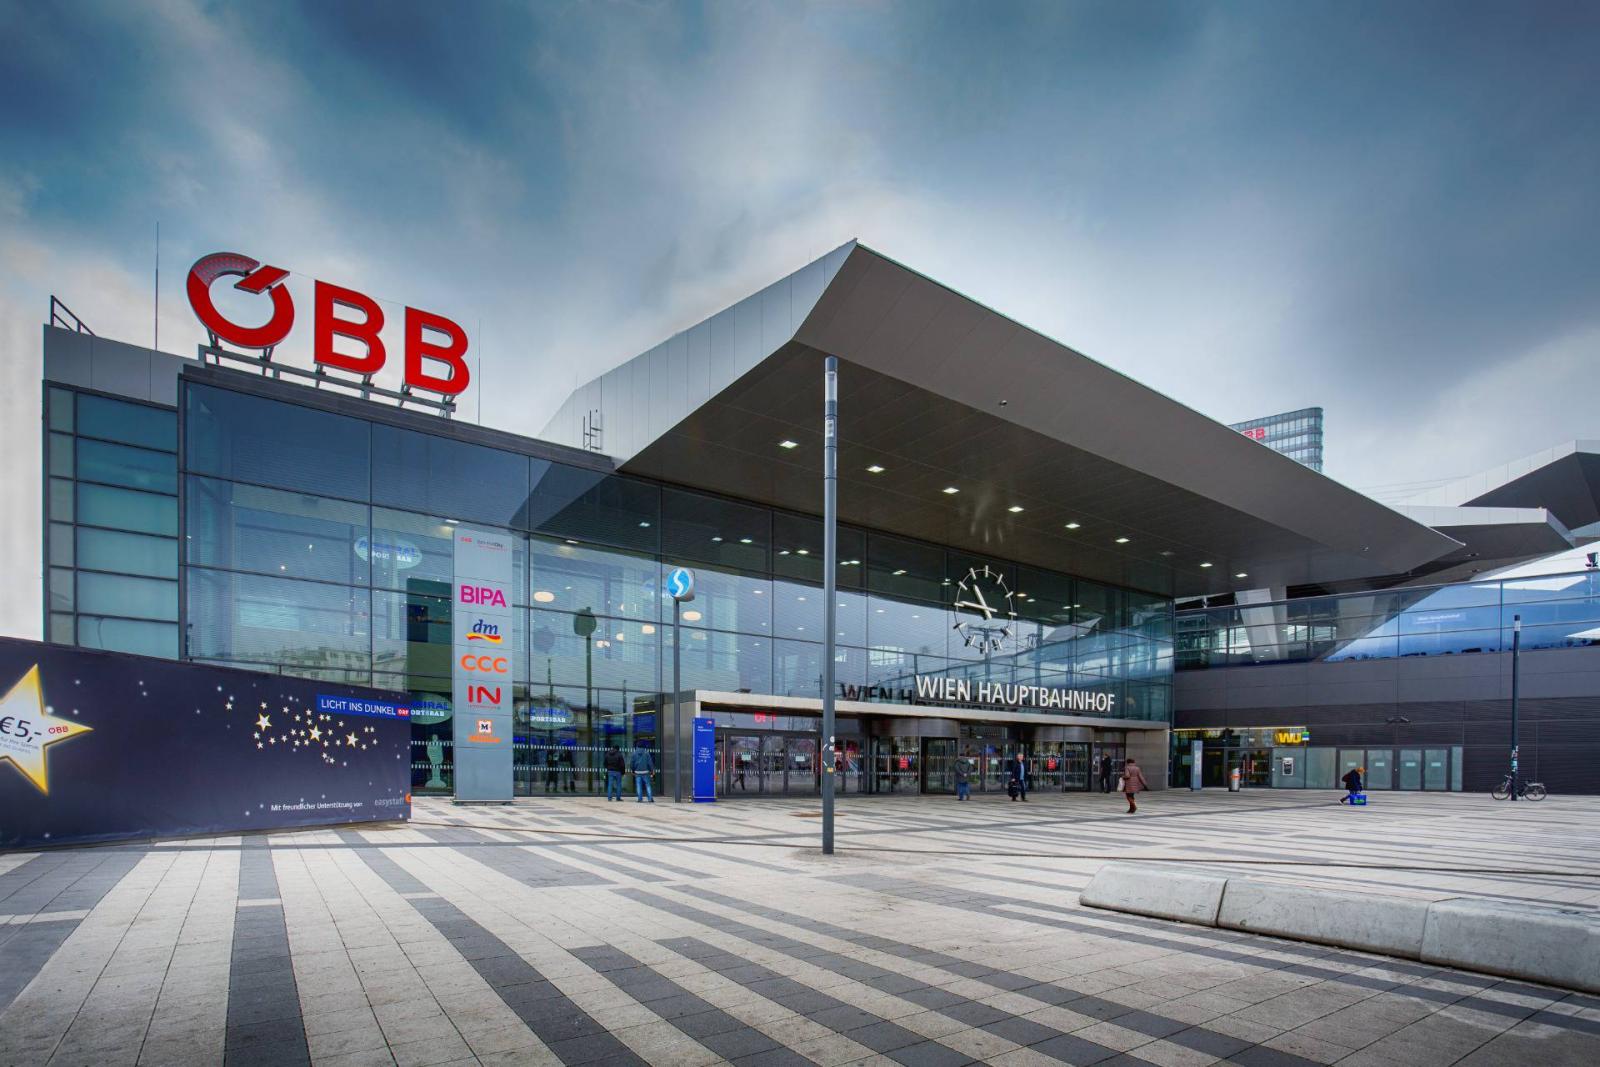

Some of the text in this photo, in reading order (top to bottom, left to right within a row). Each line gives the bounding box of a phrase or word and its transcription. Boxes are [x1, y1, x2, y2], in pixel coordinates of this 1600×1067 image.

[460, 584, 507, 608] BIPA
[472, 619, 499, 635] dm
[460, 654, 508, 673] CCC
[467, 685, 501, 705] IN
[915, 675, 971, 701] WIEN
[978, 681, 1115, 712] HAUPTBAHNHOF
[321, 699, 409, 716] LICHT INS DUNKEL ORF
[1279, 732, 1301, 744] WU
[283, 803, 315, 811] freundlicher
